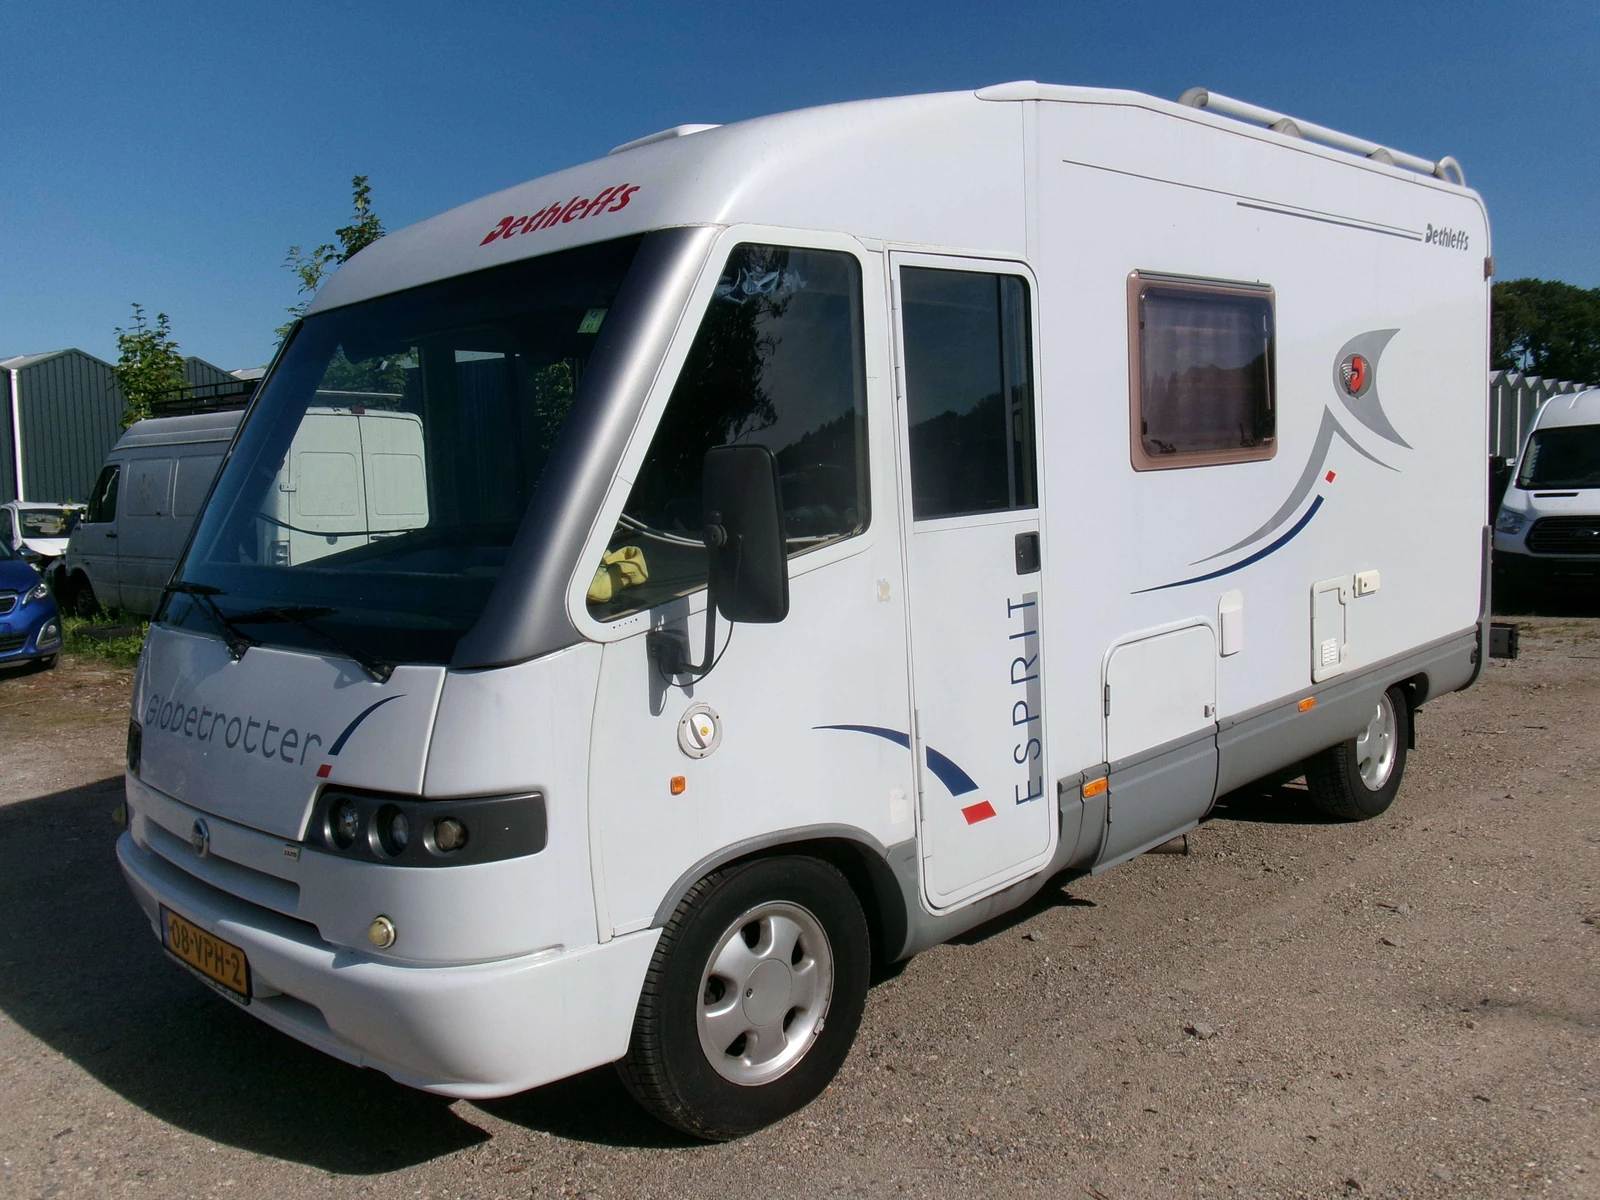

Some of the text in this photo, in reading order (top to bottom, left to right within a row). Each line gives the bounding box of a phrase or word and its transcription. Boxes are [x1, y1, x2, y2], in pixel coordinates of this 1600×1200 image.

[145, 694, 322, 766] Globetrotter
[1006, 597, 1043, 806] ESPRIT
[169, 918, 242, 986] 08-VPH-2
